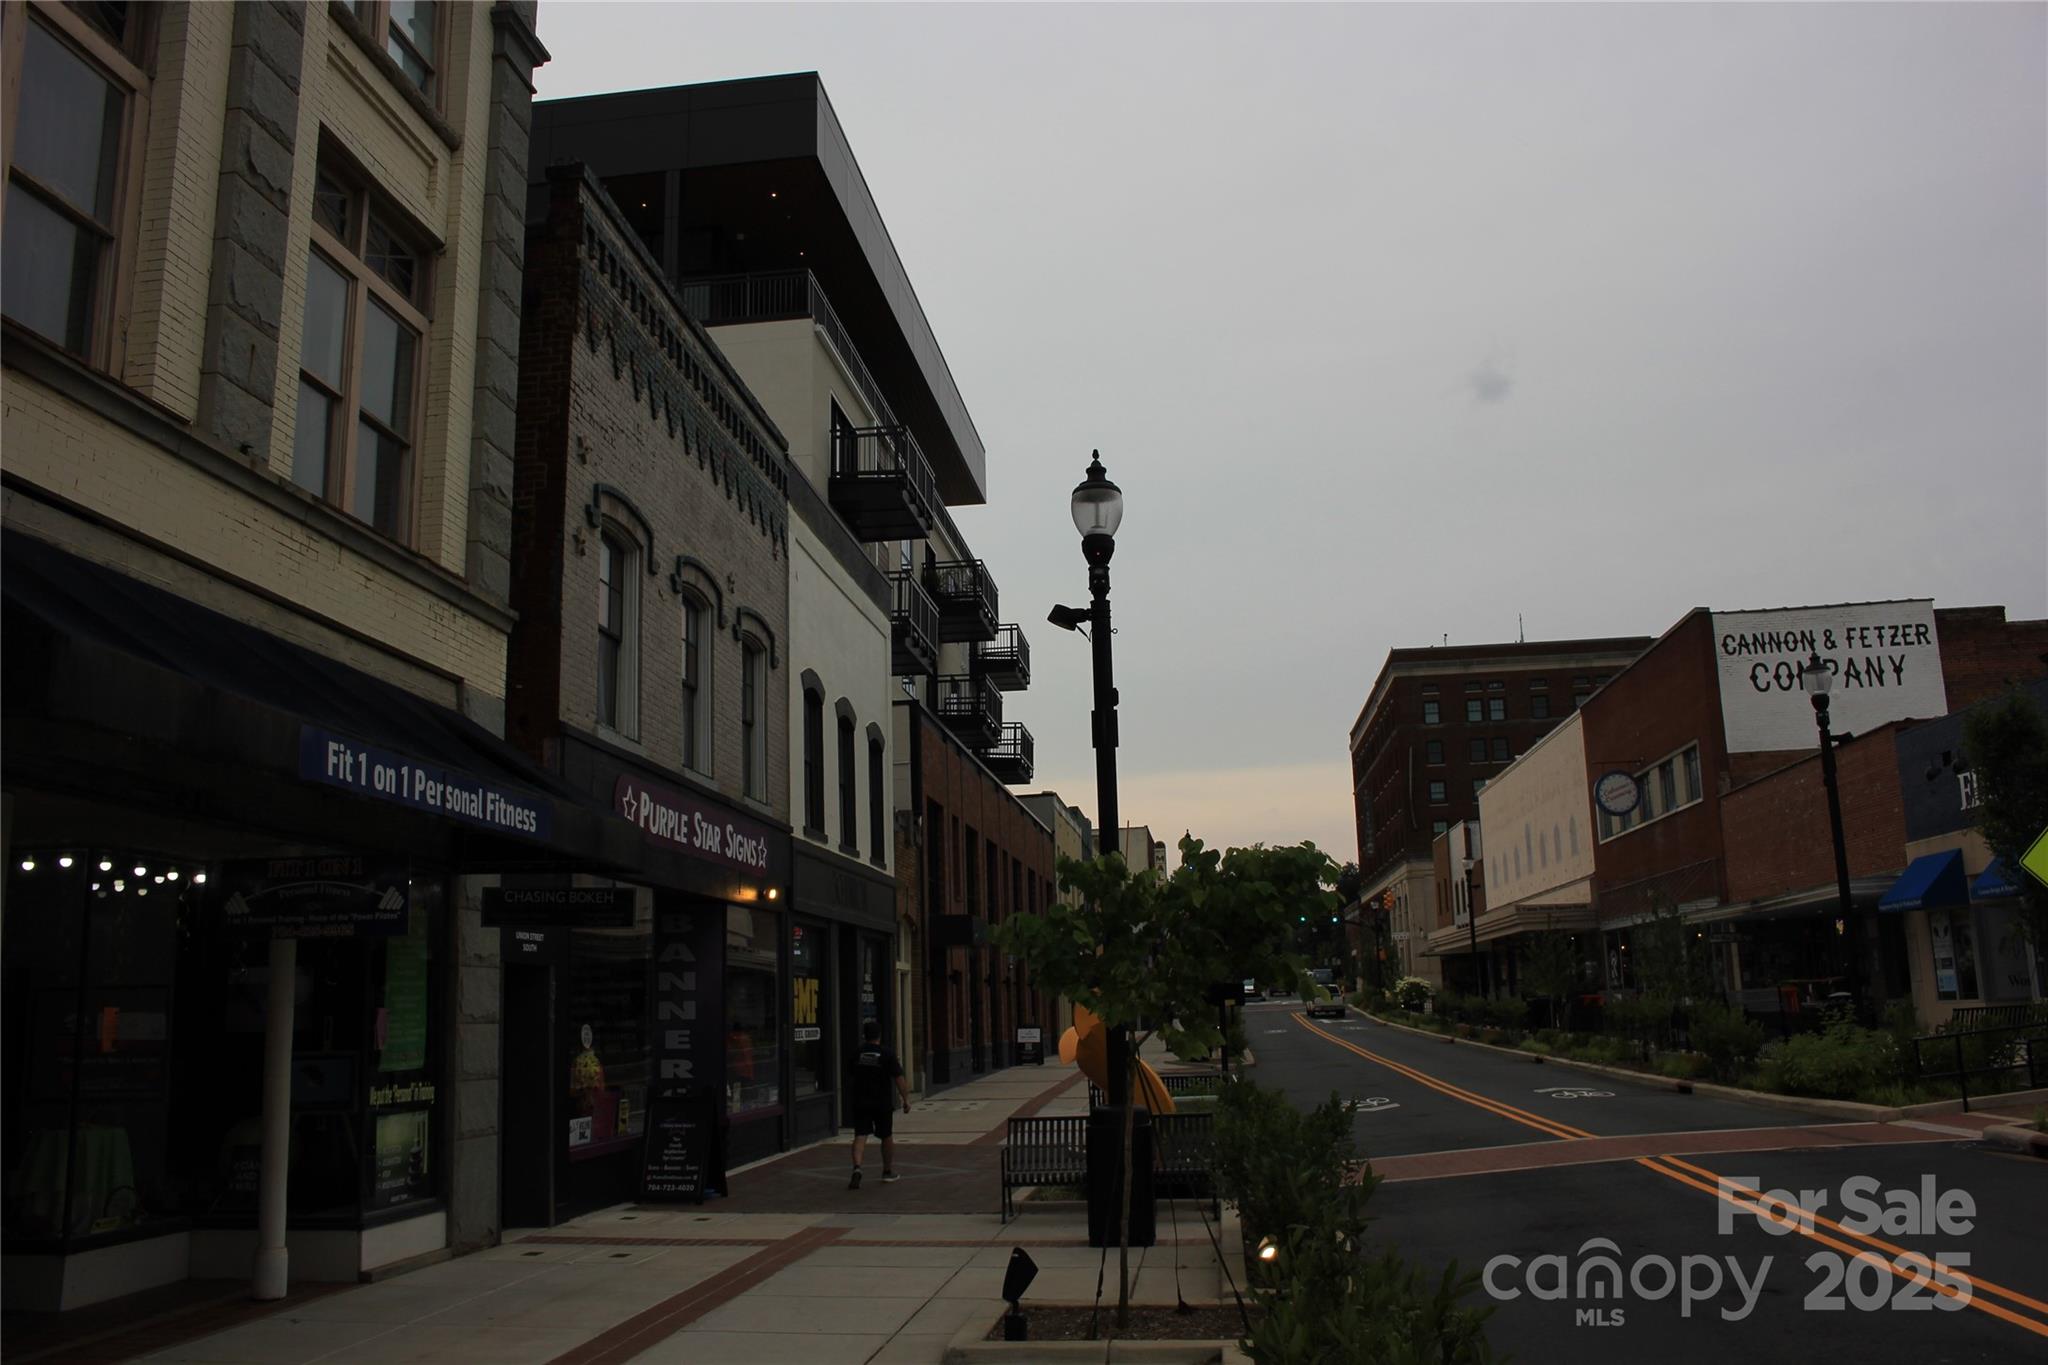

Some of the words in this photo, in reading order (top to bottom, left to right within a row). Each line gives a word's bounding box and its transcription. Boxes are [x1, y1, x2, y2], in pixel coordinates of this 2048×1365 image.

[1721, 630, 1816, 655] CANNON
[1823, 628, 1837, 650] &
[1846, 623, 1931, 649] FETZER
[327, 740, 354, 783] Fit
[358, 752, 367, 786] 1
[373, 764, 396, 794] on
[400, 766, 408, 798] 1
[415, 769, 483, 820] Personal
[486, 791, 537, 833] Fitness
[639, 791, 688, 844] PURPLE
[693, 811, 721, 854] STAR
[725, 823, 757, 867] SIGNS
[504, 890, 567, 904] CHASING
[568, 890, 615, 904] BOKEH
